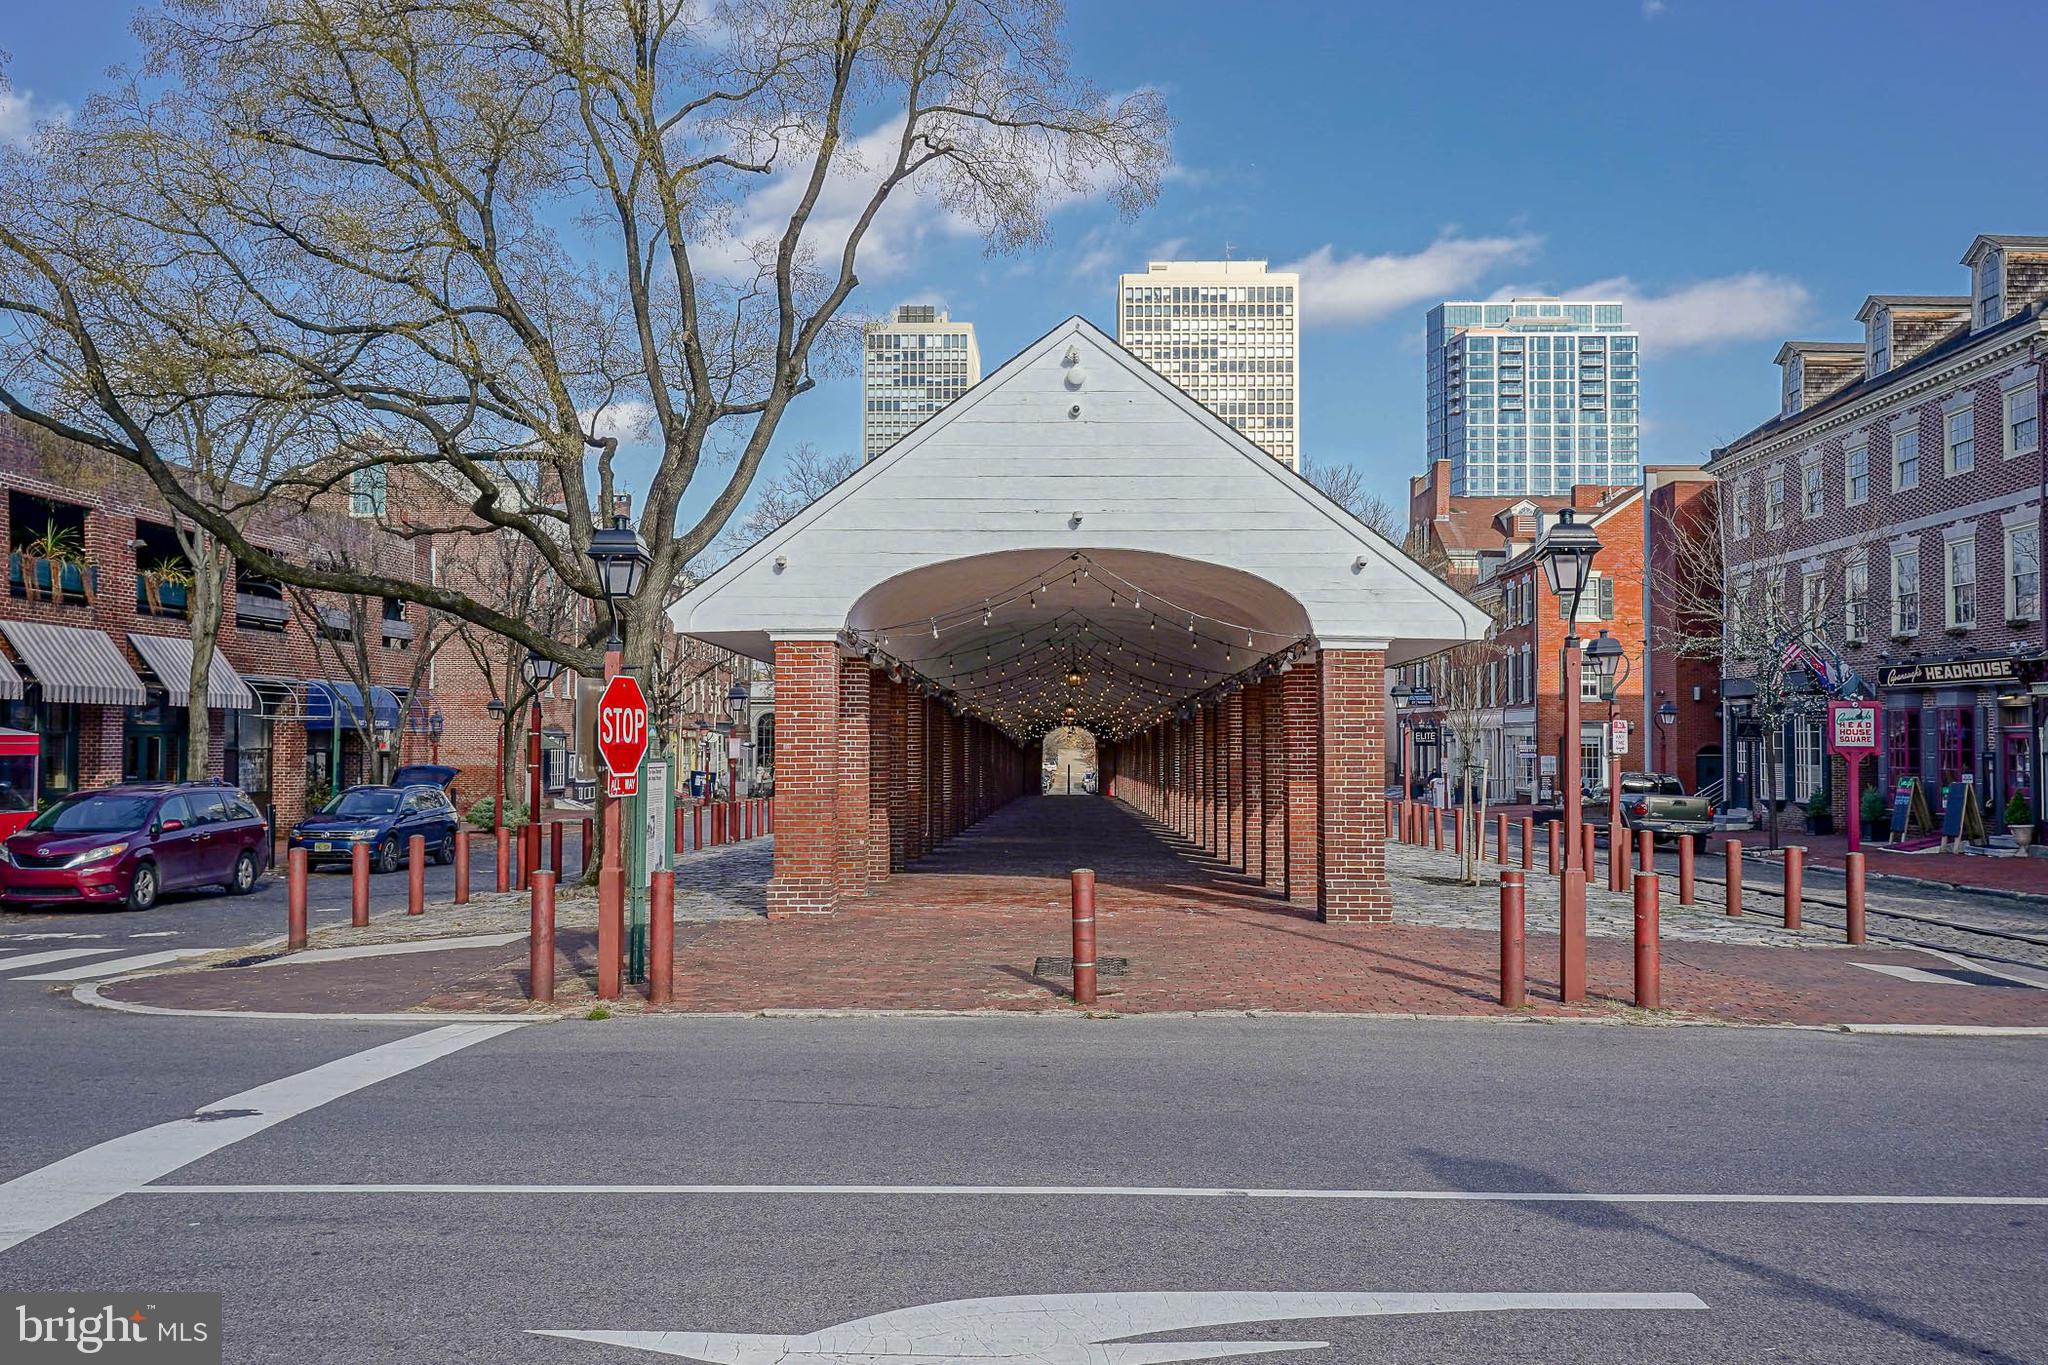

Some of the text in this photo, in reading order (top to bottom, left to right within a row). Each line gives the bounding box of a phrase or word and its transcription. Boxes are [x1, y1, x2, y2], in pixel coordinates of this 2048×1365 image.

[1925, 661, 2012, 679] HEADHOUSE
[602, 707, 645, 744] STOP
[1415, 731, 1436, 740] ELITE
[611, 778, 635, 791] ALL WAY
